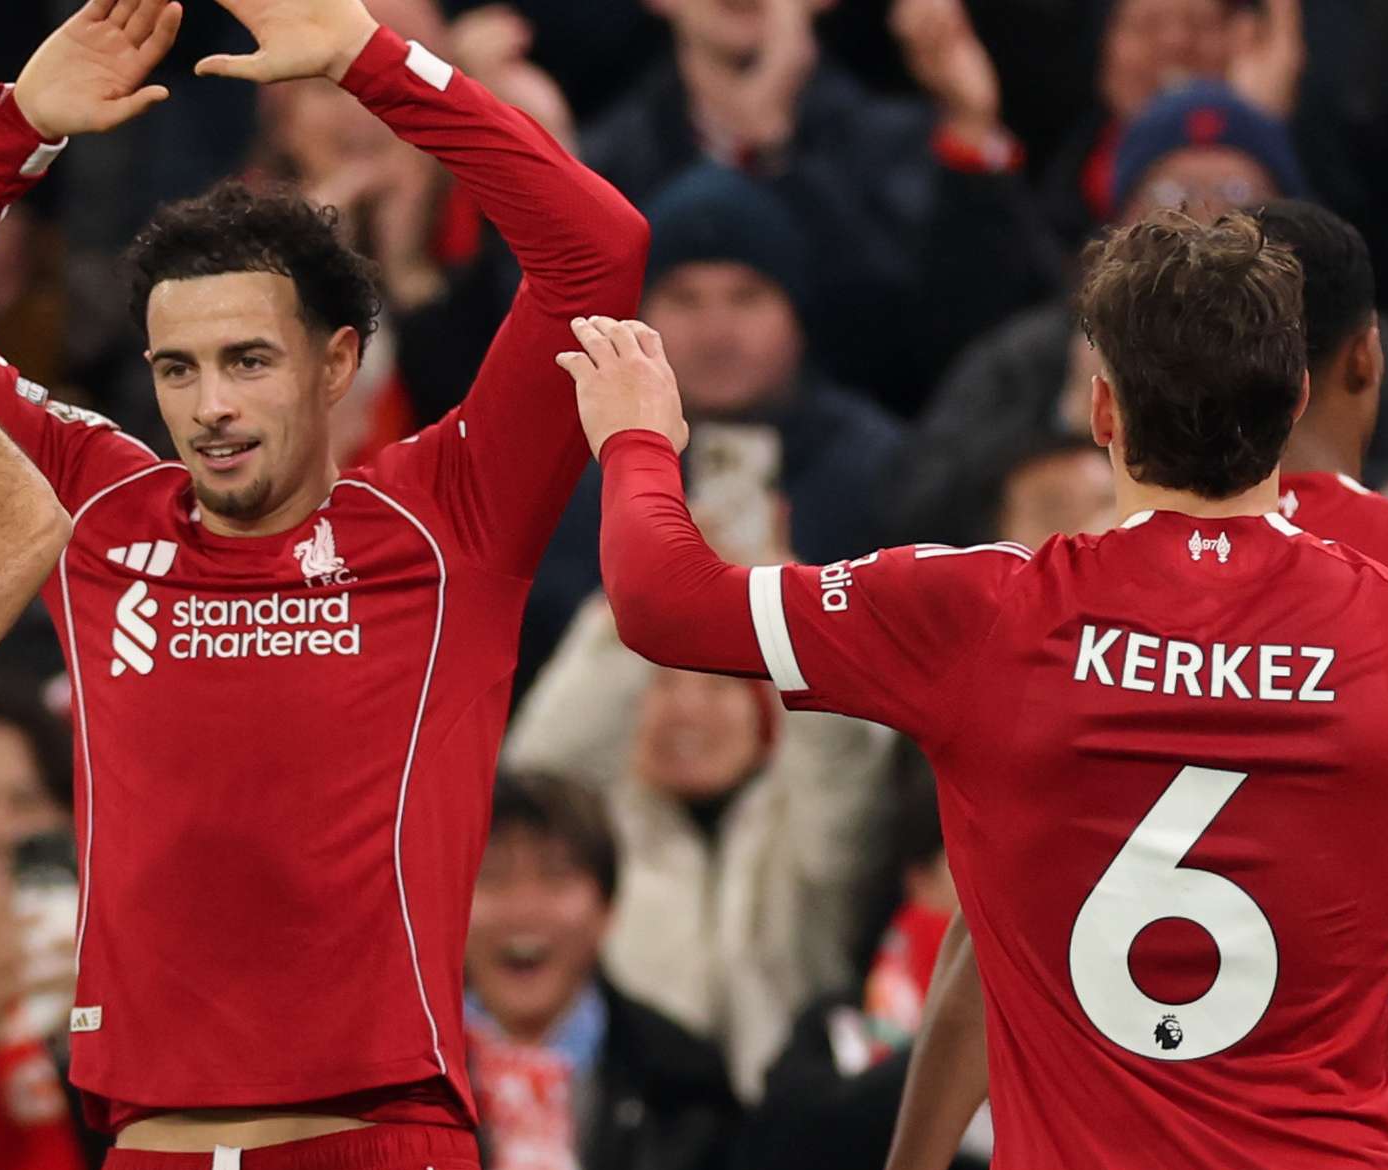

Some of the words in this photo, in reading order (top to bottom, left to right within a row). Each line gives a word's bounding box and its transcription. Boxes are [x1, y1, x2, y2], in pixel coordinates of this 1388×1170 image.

[171, 591, 350, 627] standard
[168, 623, 361, 660] chartered
[1073, 624, 1337, 703] KERKEZ
[1068, 765, 1280, 1062] 6
